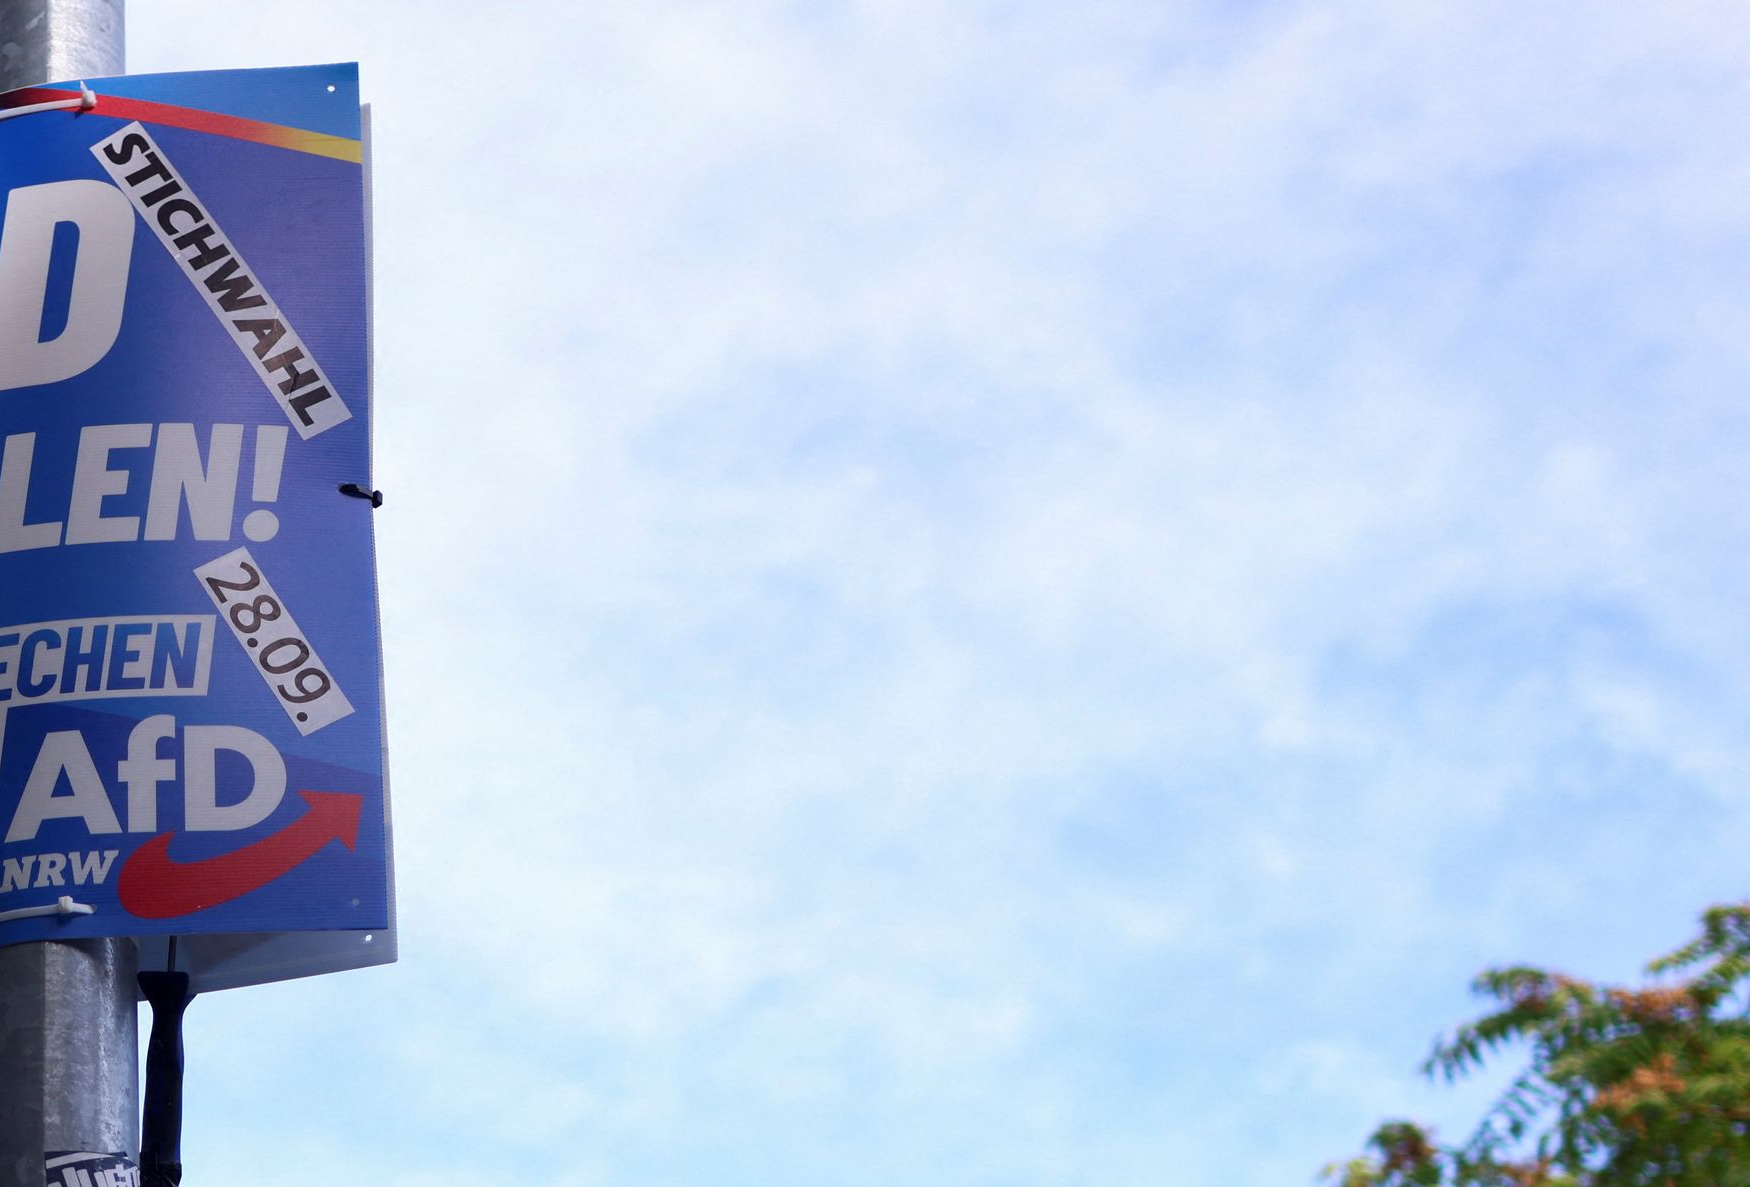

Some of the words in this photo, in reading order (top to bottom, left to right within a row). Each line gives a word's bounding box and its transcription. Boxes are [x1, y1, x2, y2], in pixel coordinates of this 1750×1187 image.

[102, 131, 333, 427] STICHWAHL
[205, 561, 331, 723] 28.09.
[3, 714, 288, 843] AfD
